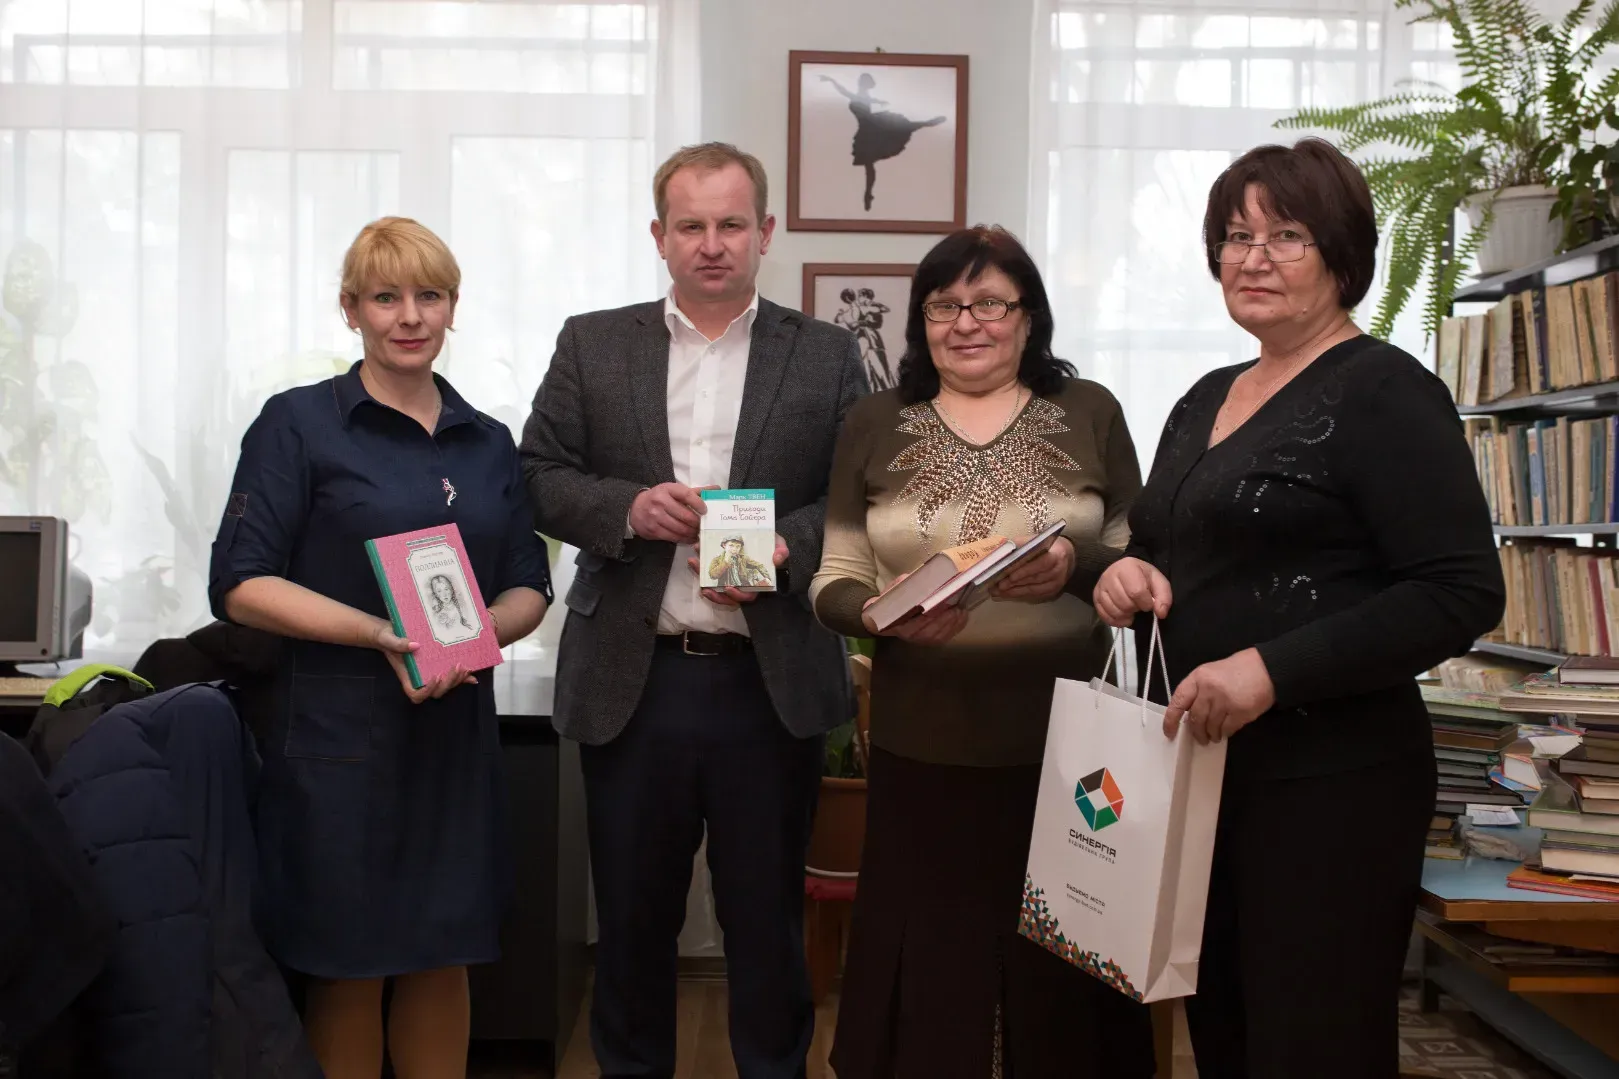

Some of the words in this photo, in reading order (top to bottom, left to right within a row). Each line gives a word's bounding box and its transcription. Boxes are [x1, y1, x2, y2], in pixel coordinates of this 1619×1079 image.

[719, 513, 738, 521] Тома
[732, 504, 767, 517] Пригоди
[1069, 828, 1117, 858] СИНЕРГІЯ
